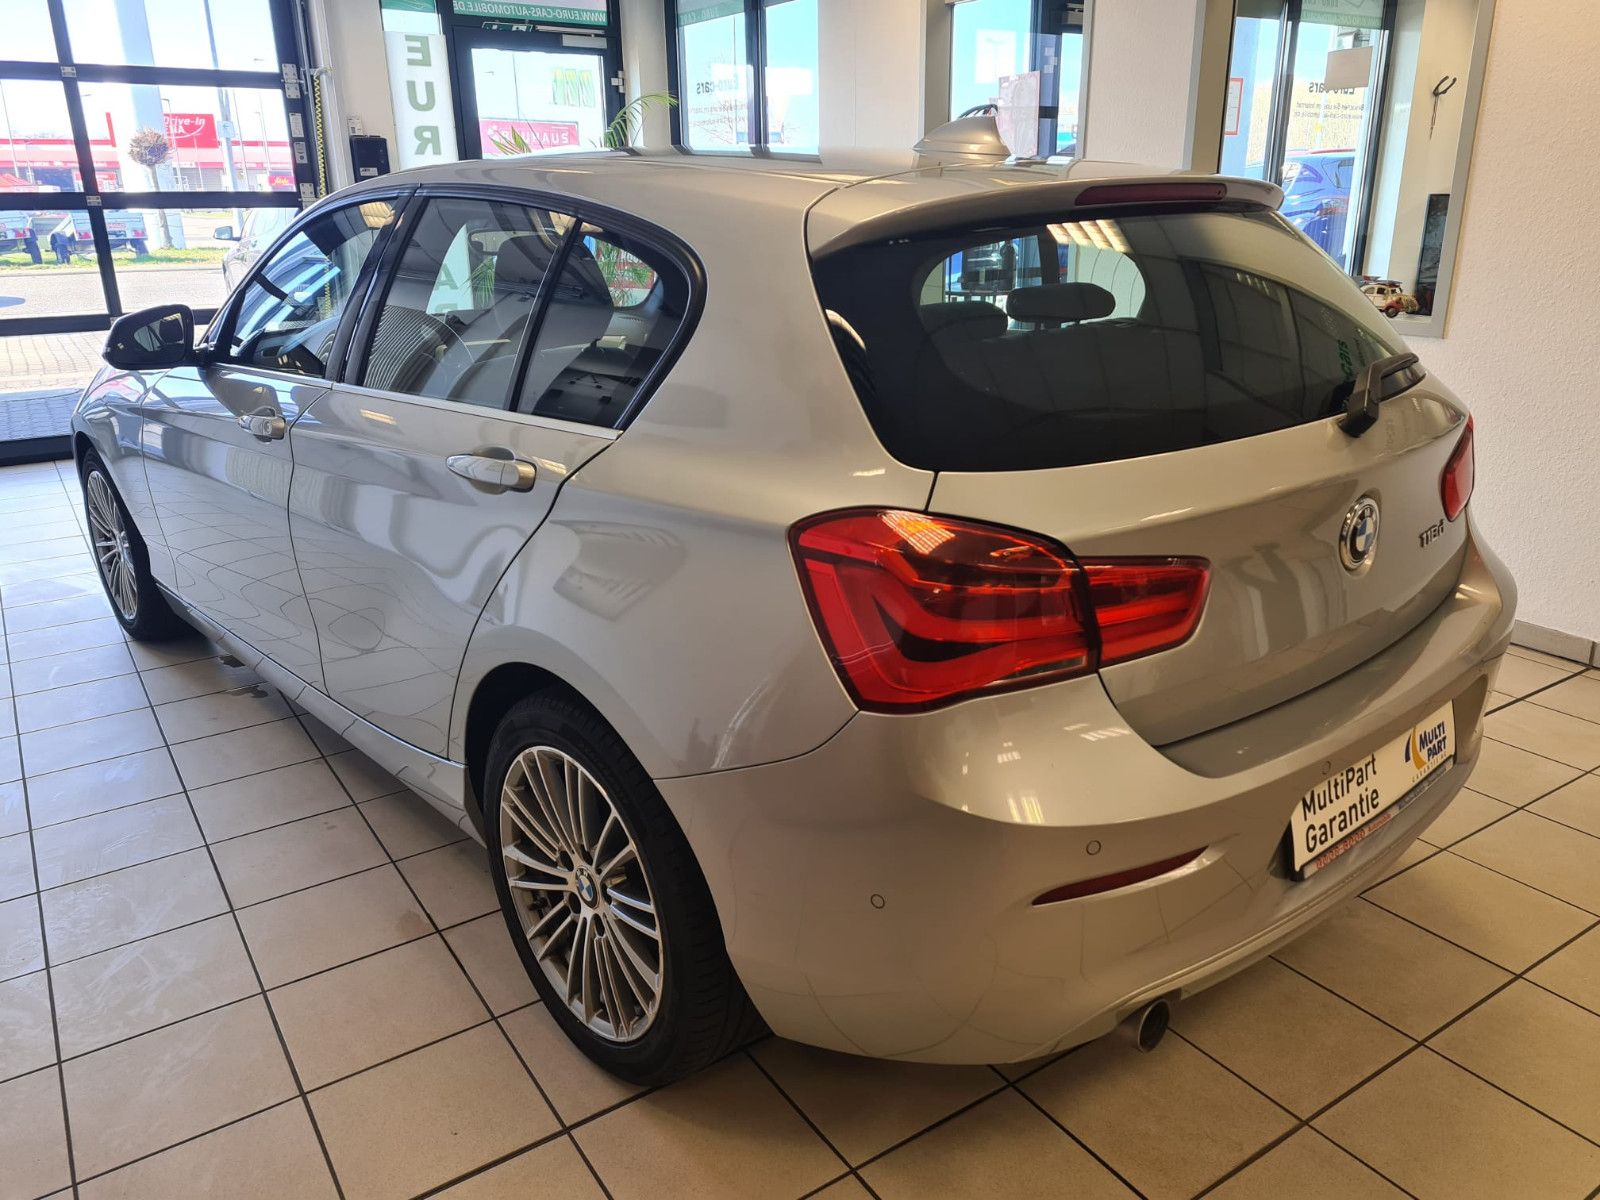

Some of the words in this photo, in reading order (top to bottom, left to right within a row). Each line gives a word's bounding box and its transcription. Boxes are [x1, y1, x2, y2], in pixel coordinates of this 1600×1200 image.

[1427, 735, 1447, 762] PART
[1302, 752, 1377, 821] MultiPart
[1305, 787, 1380, 854] Garantie
